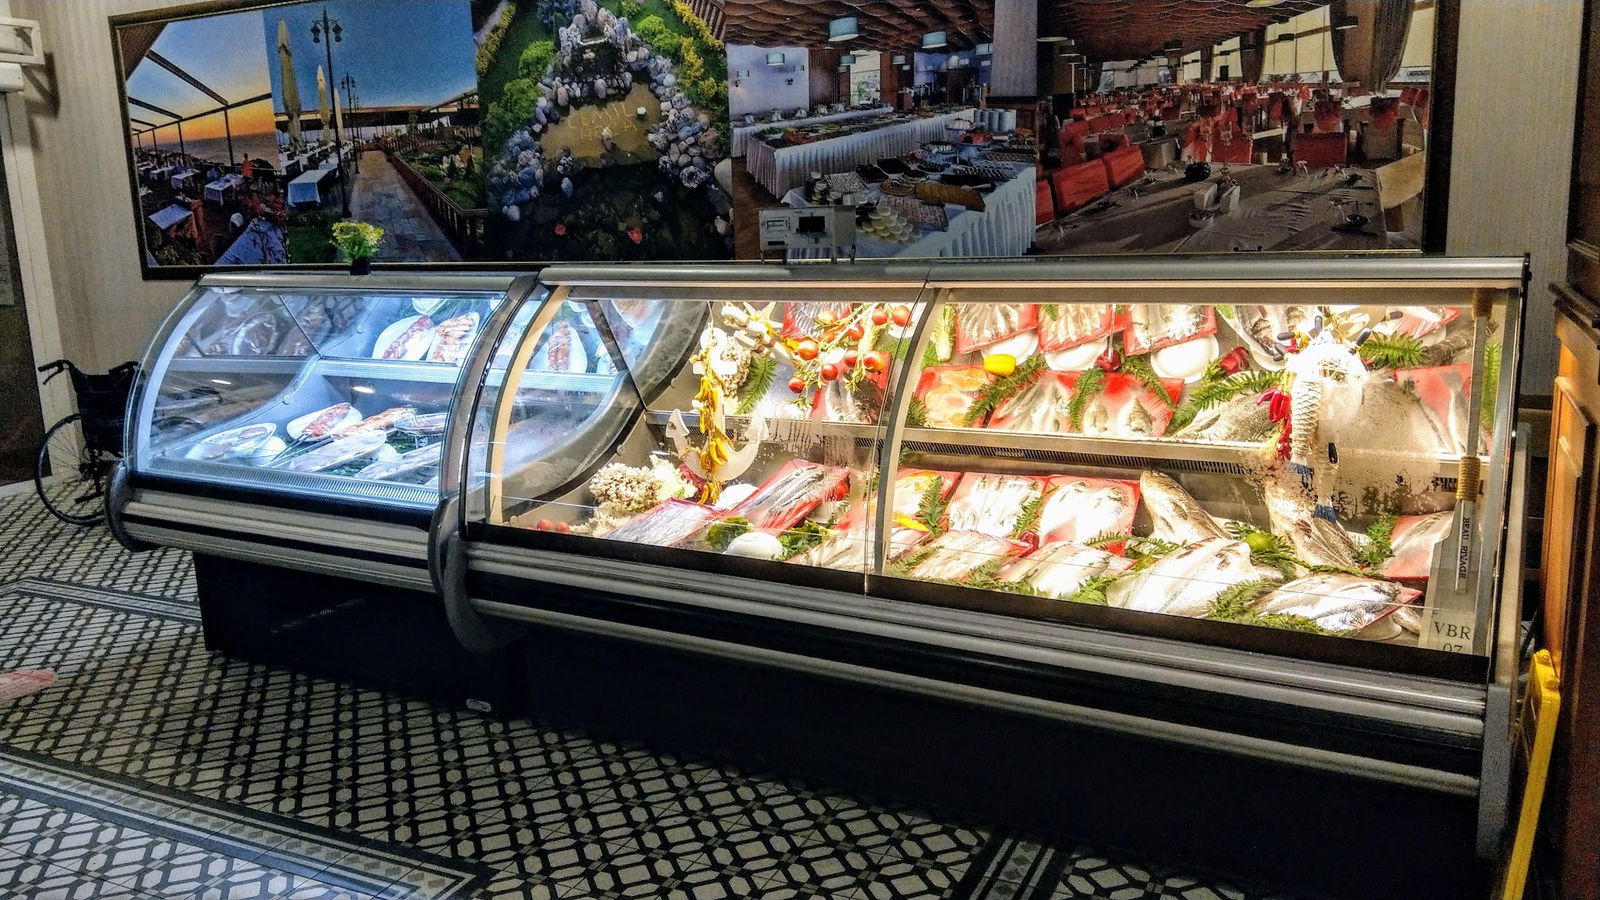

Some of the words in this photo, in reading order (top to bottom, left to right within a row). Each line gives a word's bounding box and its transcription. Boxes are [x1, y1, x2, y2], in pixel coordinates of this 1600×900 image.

[1461, 517, 1470, 540] BEAU
[1459, 545, 1469, 580] RIVAGE
[1433, 621, 1471, 641] VBR
